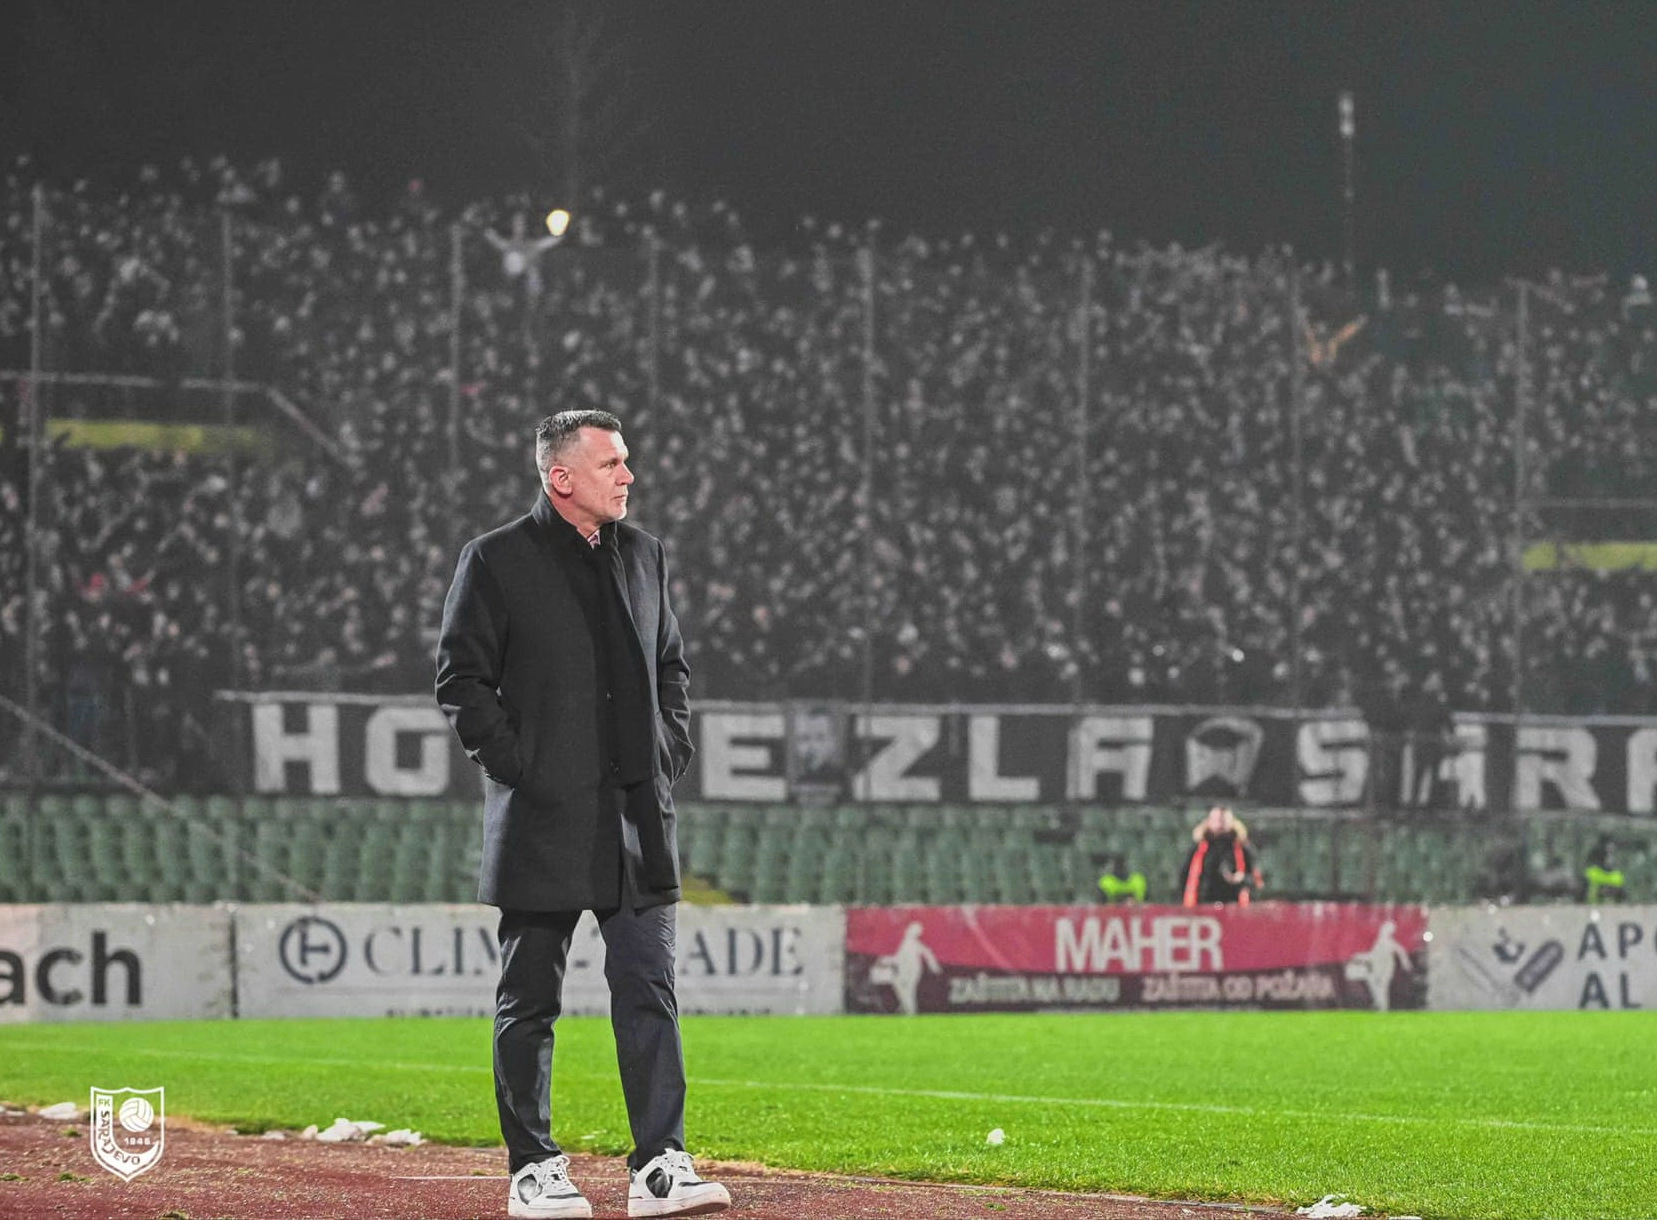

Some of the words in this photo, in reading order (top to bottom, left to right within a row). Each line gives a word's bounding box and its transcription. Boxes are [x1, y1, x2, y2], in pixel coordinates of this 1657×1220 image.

[254, 703, 788, 799] HOE
[853, 714, 1153, 800] ZLA
[1056, 916, 1223, 972] MAHER
[1577, 922, 1657, 959] AP
[1578, 971, 1642, 1009] AL
